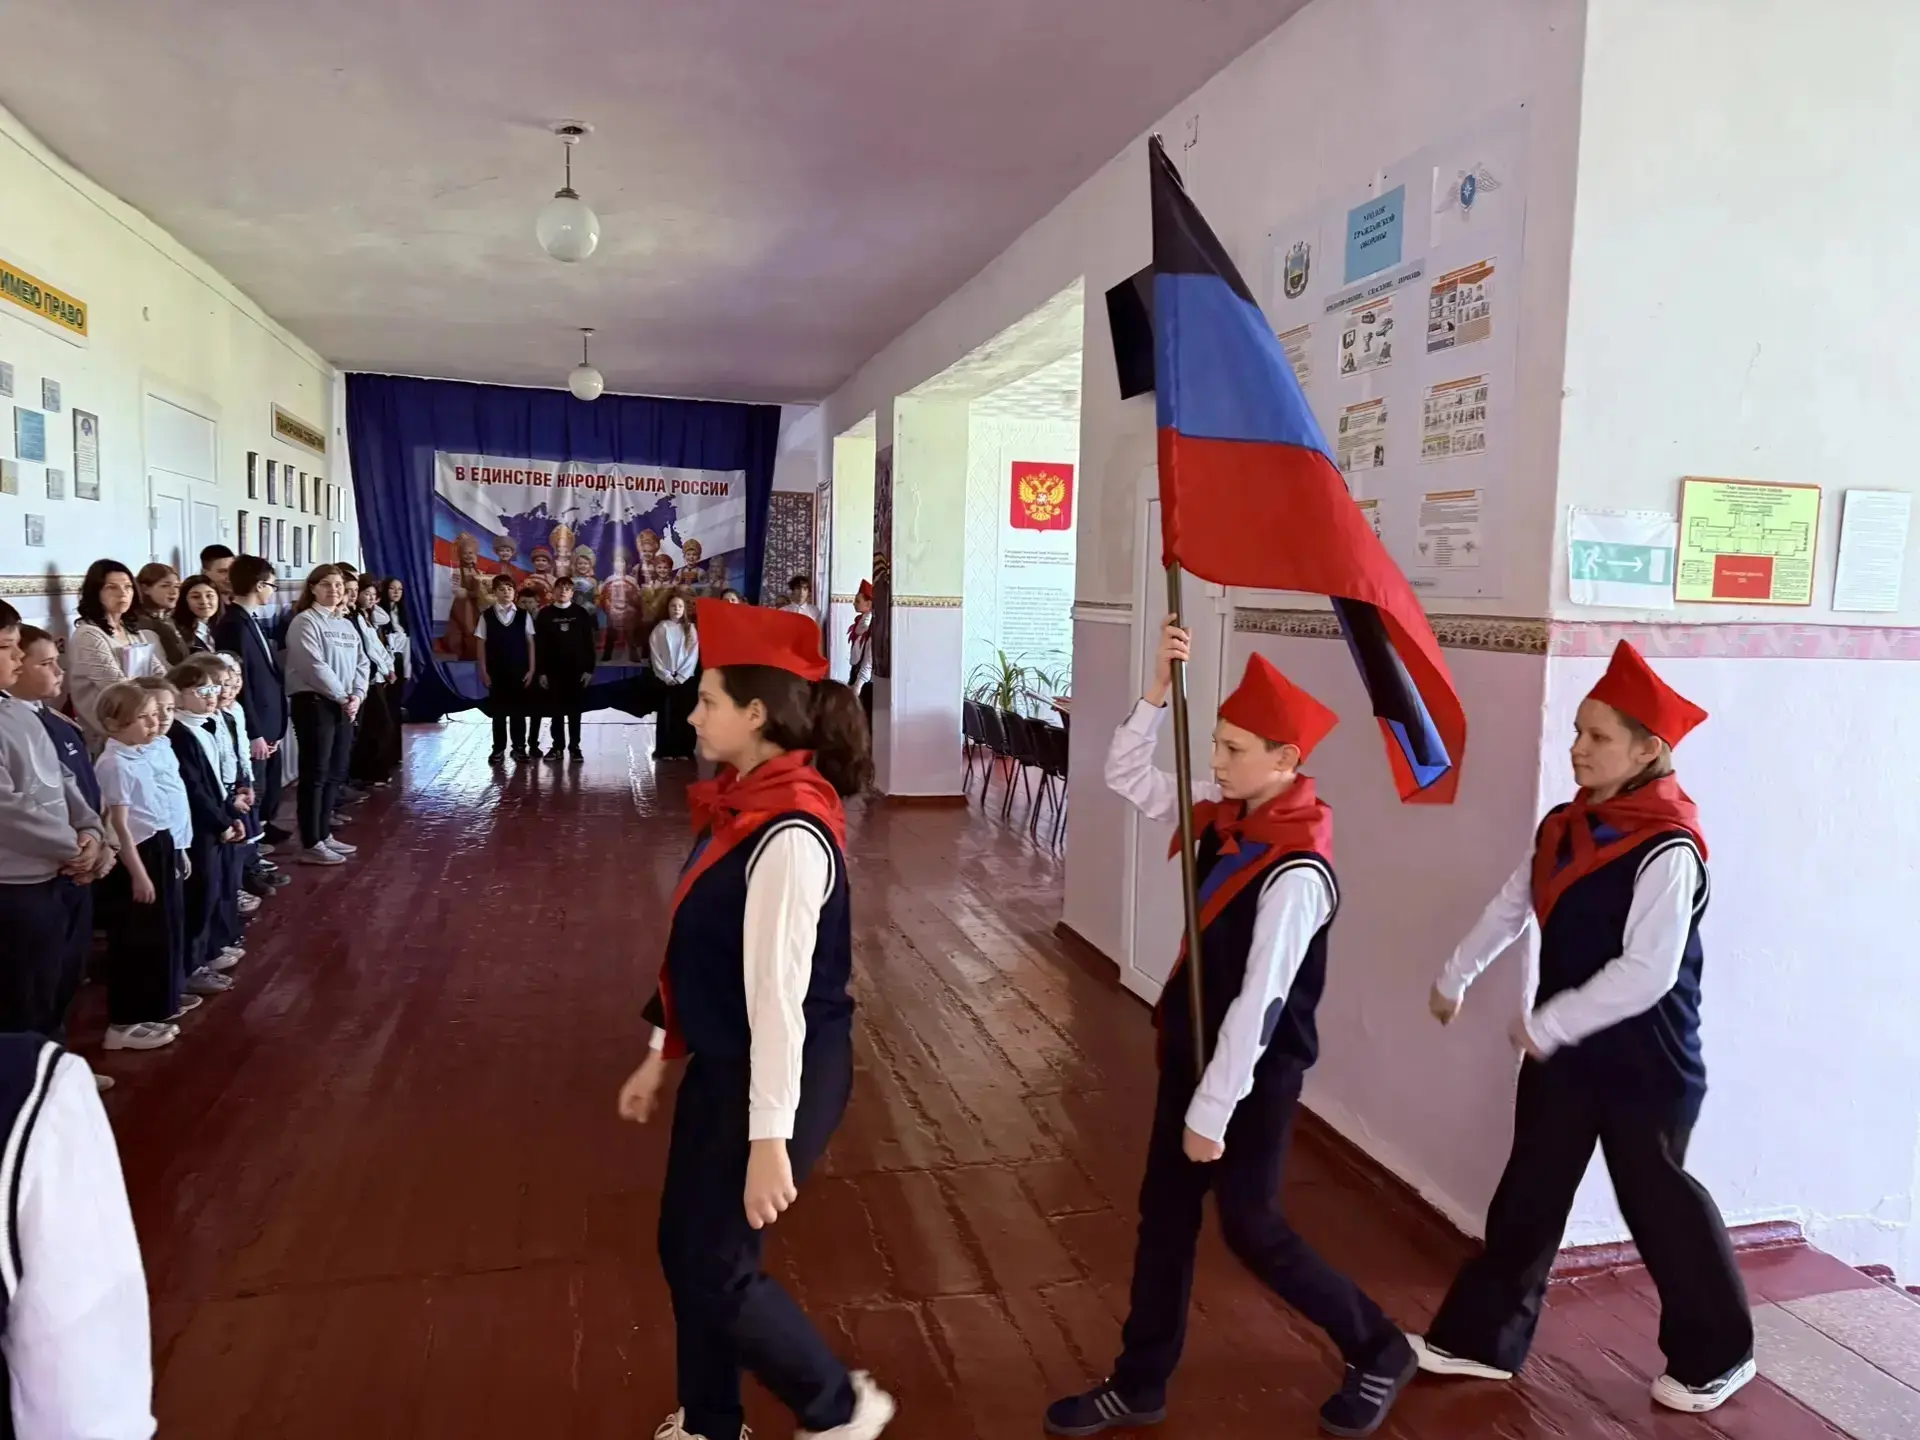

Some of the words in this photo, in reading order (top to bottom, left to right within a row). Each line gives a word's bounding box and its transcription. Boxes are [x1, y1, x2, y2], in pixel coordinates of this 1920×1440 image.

[44, 291, 84, 328] ПРАВО
[455, 466, 466, 481] В
[470, 466, 552, 488] ЕДИНСТВЕ
[671, 479, 729, 496] РОССИИ
